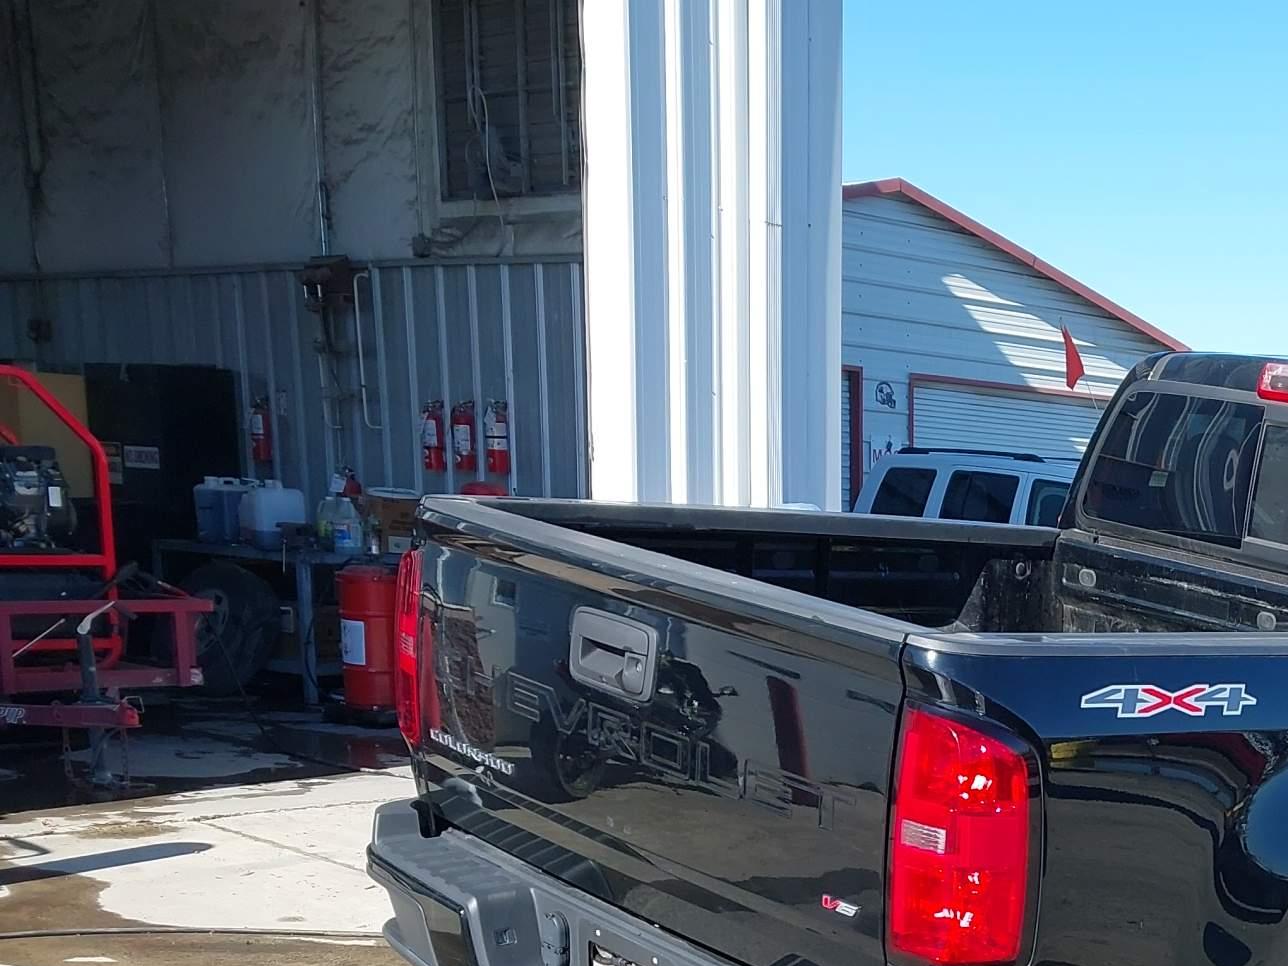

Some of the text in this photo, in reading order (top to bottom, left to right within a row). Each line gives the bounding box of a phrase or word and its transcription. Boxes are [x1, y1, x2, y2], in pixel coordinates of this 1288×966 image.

[429, 728, 515, 775] COLORADO
[444, 653, 857, 830] CHEVROLET
[822, 894, 861, 917] V6
